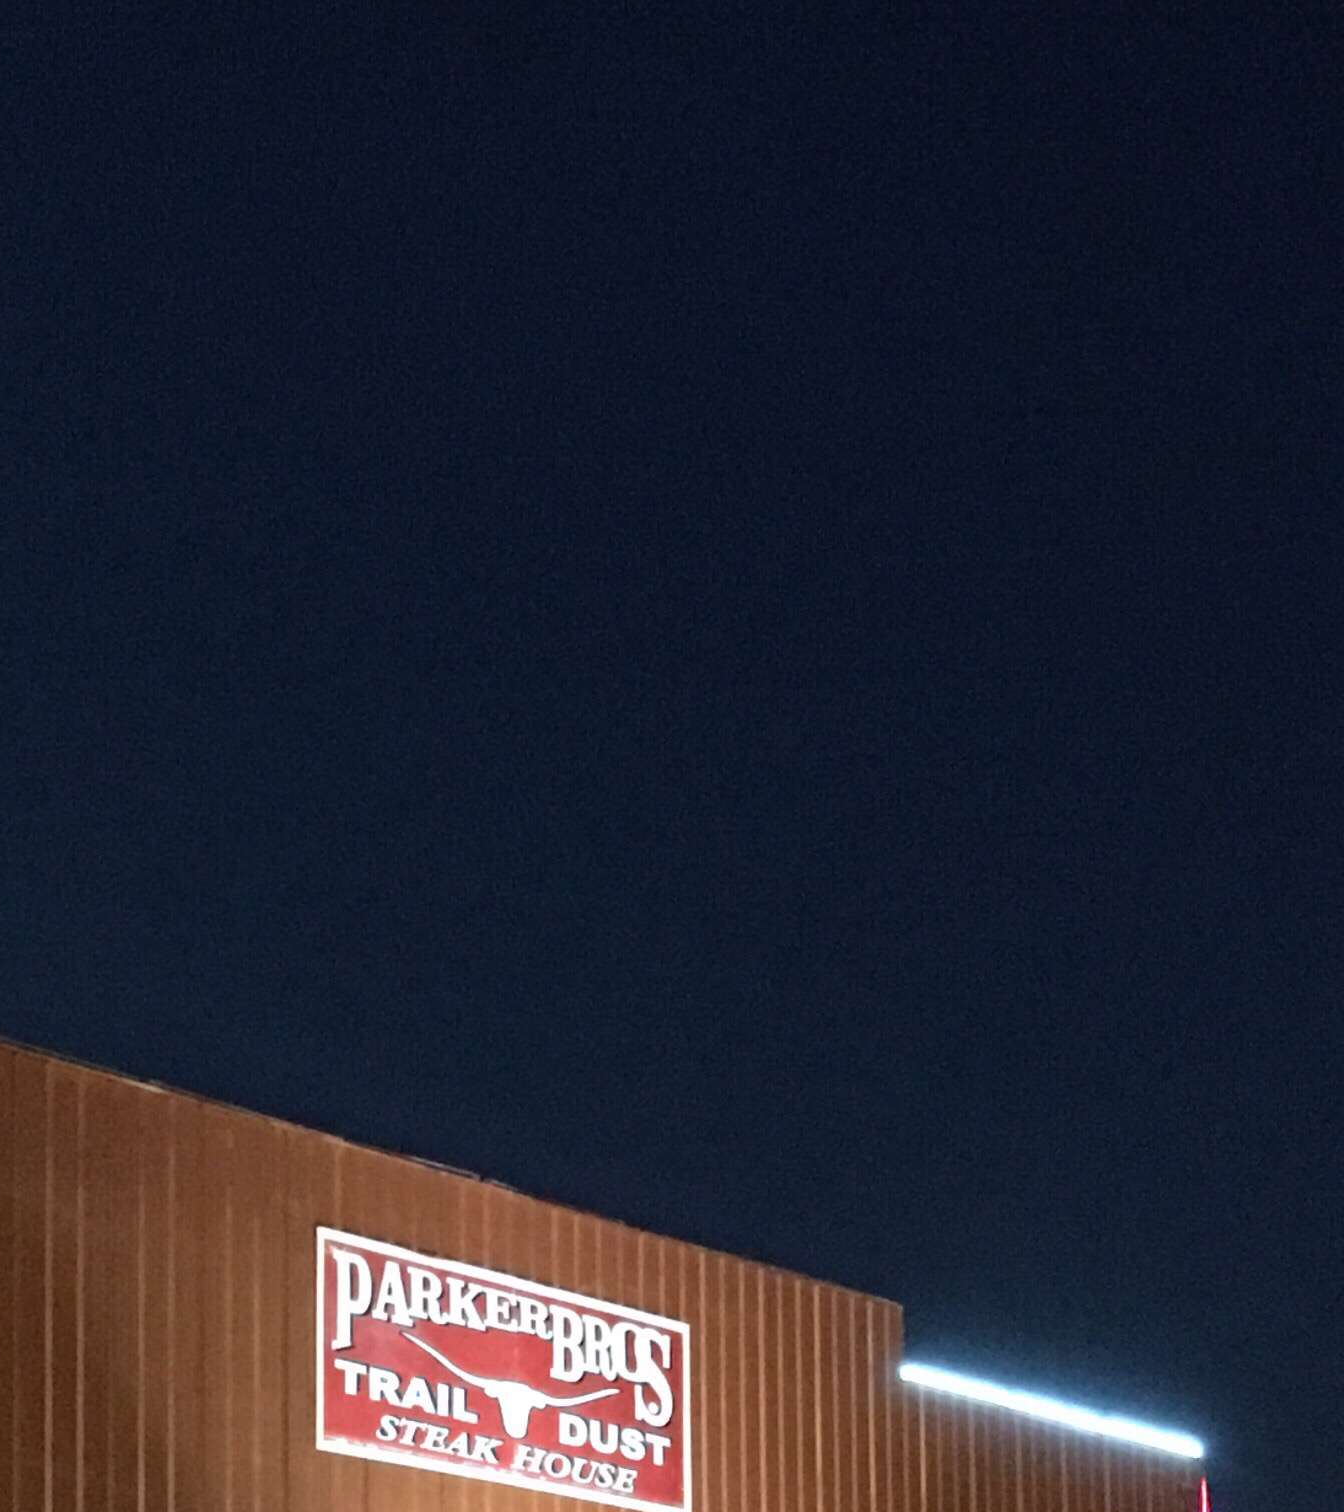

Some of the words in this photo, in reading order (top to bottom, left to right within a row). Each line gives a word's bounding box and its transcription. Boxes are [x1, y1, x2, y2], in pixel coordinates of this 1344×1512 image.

[331, 1248, 552, 1350] PARKER
[551, 1304, 673, 1428] BROS
[334, 1358, 479, 1425] TRAIL
[558, 1411, 671, 1467] DUST
[375, 1415, 504, 1465] STEAK
[512, 1444, 639, 1494] HOUSE
